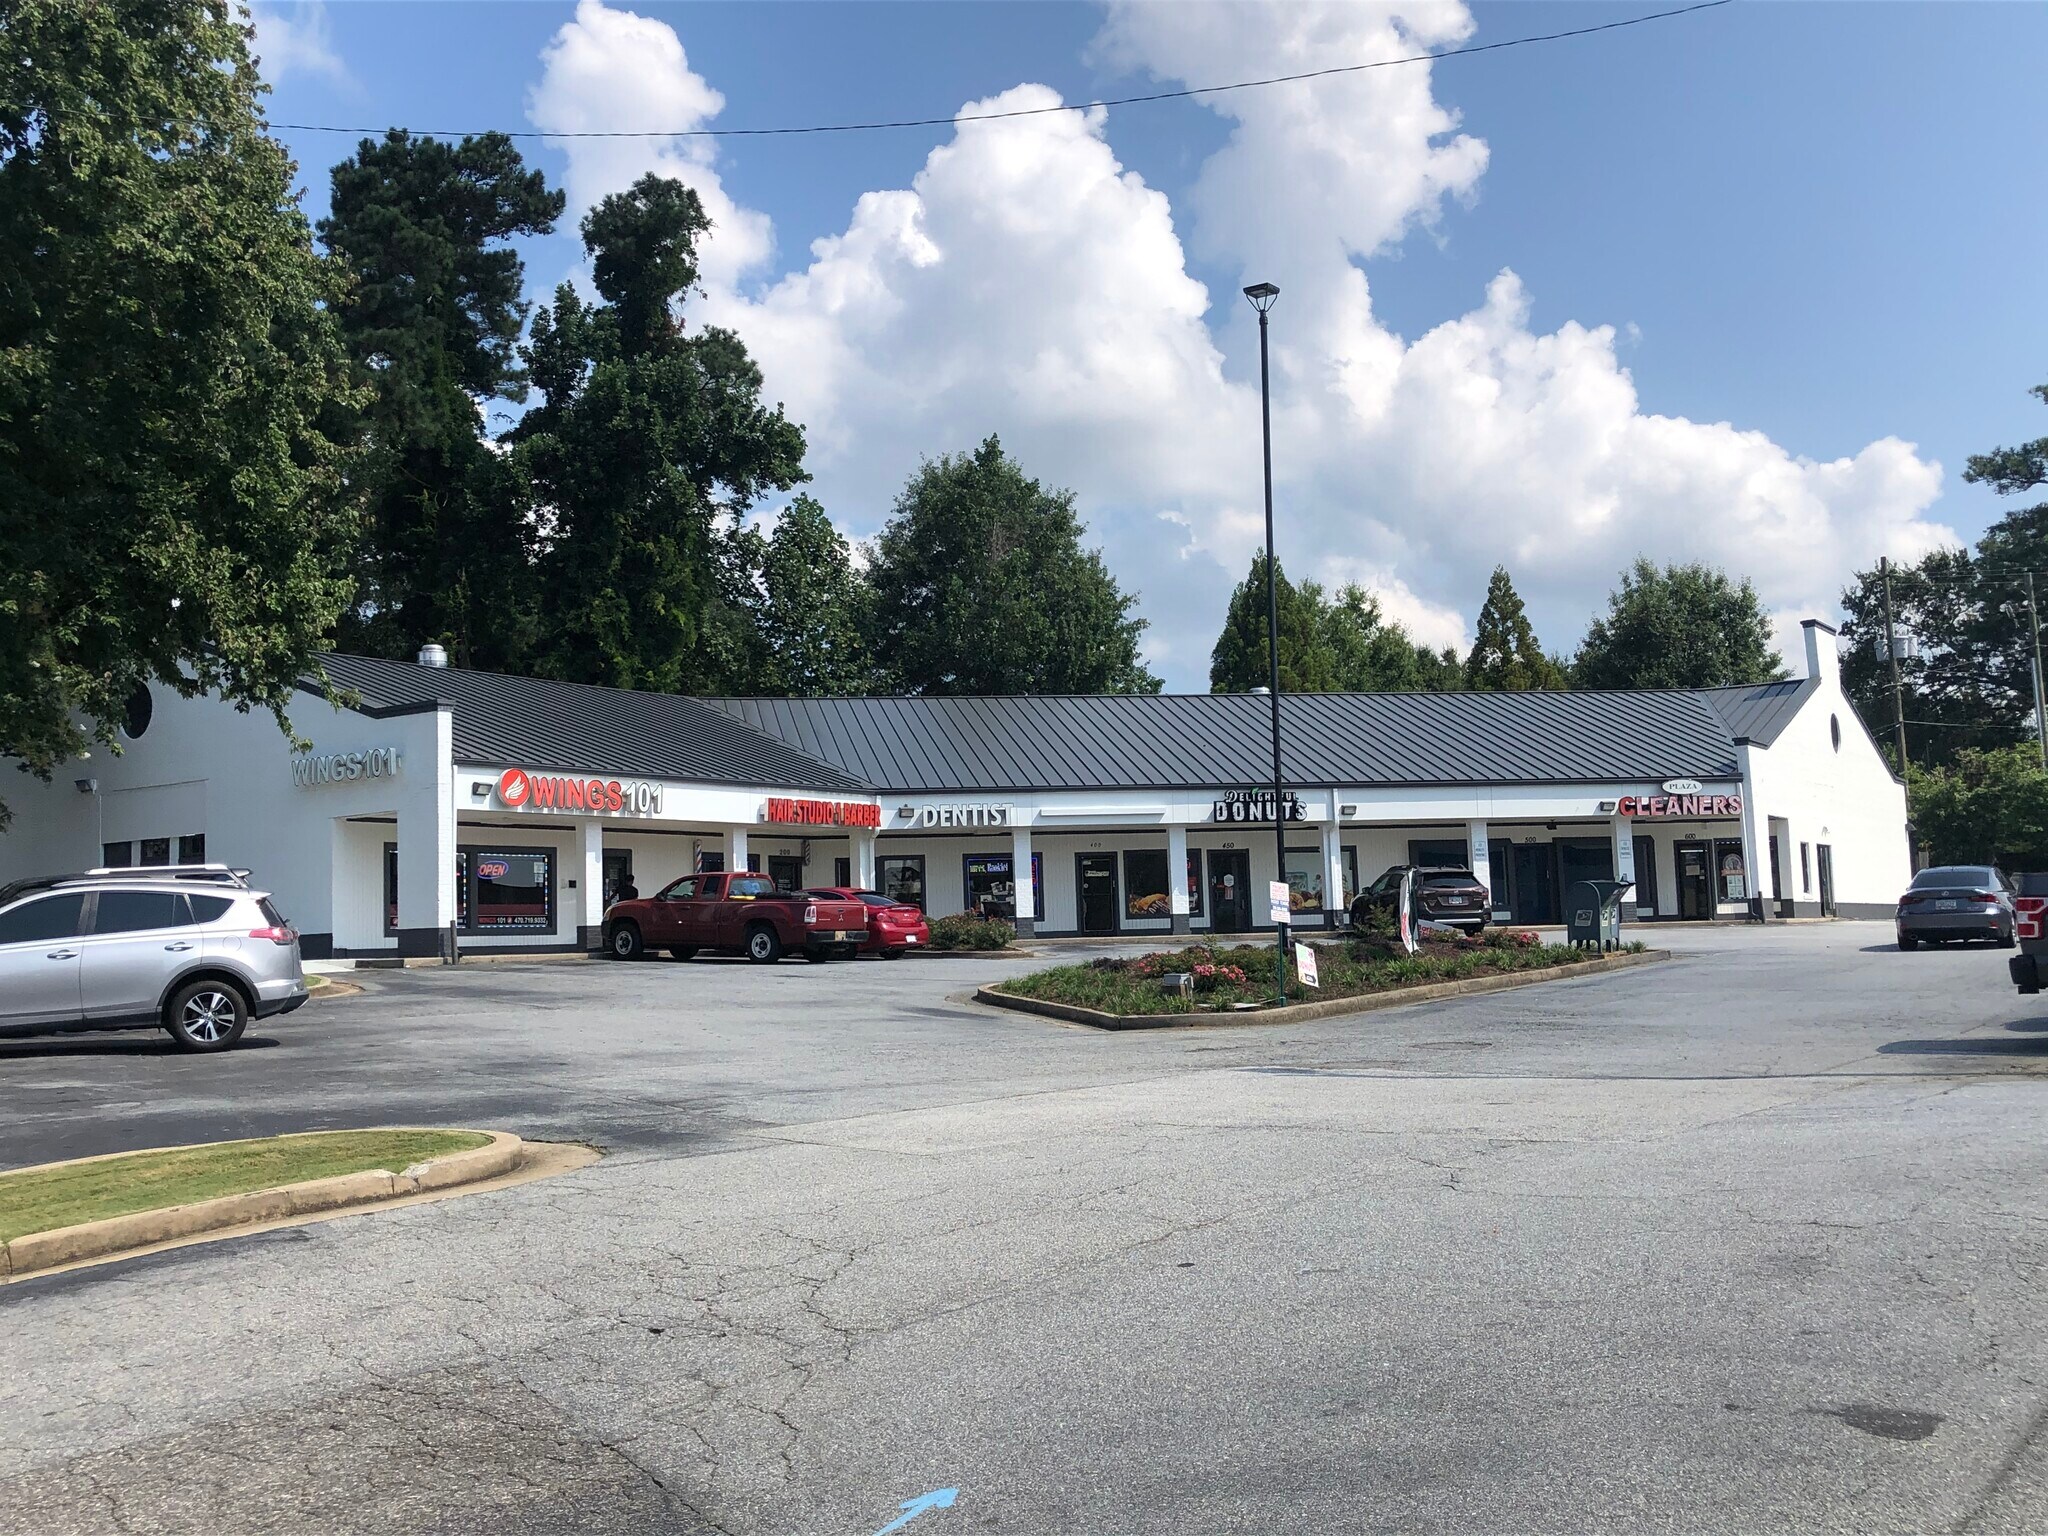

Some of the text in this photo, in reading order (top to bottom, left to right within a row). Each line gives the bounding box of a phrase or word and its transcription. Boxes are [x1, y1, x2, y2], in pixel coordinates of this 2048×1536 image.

[291, 747, 396, 787] WINGS 101
[532, 775, 663, 814] WINGS 101
[1225, 789, 1299, 803] DELIGHTUL
[1619, 794, 1742, 816] CLEANERS
[768, 797, 795, 823] HAIR
[796, 799, 834, 825] STUDIO
[843, 802, 882, 827] BARBER
[922, 803, 1015, 828] DENTIST
[1216, 801, 1308, 821] DONUTS
[480, 864, 506, 876] OPEN
